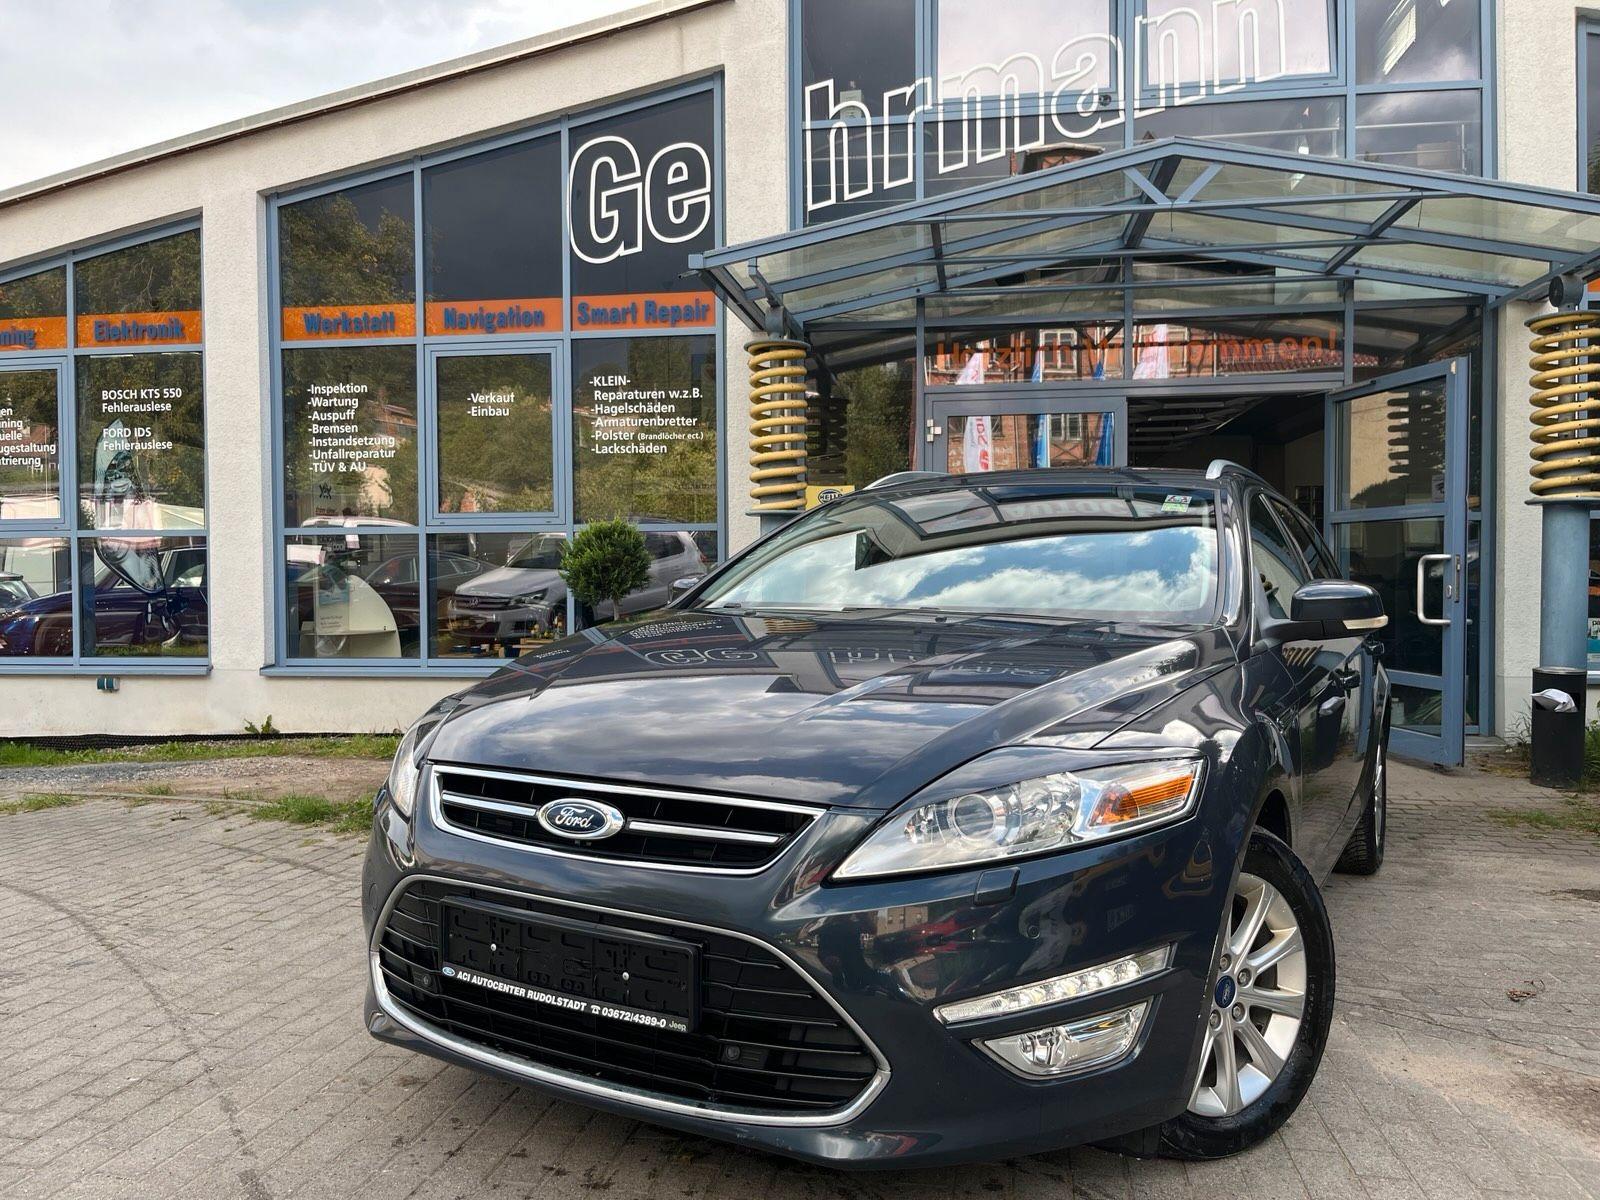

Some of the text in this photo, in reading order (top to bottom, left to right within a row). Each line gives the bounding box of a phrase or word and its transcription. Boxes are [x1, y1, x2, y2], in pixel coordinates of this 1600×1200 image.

[568, 135, 712, 264] Ge
[444, 304, 544, 334] Navigation
[577, 299, 709, 327] Smart Repair
[303, 311, 395, 334] Werkstatt
[94, 316, 185, 342] Elektronik
[589, 376, 631, 387] -KLEIN-
[102, 388, 182, 400] BOSCH KTS 550
[307, 383, 368, 396] -Inspektion
[594, 388, 703, 402] Reparaturen w.z.B.
[307, 397, 359, 408] -Wartung
[467, 392, 515, 403] -Verkauf
[0, 407, 13, 418] en
[102, 402, 172, 413] Fehlerauslese
[467, 405, 510, 417] -Einbau
[590, 402, 676, 416] -Hagelschäden
[308, 409, 355, 422] -Auspuff
[591, 415, 698, 428] -Armaturenbretter
[0, 418, 23, 430] ning
[308, 424, 359, 433] -Bremsen
[102, 427, 152, 438] FORD IDS
[591, 429, 635, 441] -Polster
[103, 439, 173, 451] Fehlerauslese
[308, 436, 395, 448] -Instandsetzung
[591, 442, 668, 454] -Lackschäden
[308, 448, 396, 461] -Unfallreparatur
[0, 455, 41, 468] trierung
[309, 460, 366, 472] -TÜV & AU
[555, 806, 594, 828] Ford
[457, 971, 471, 982] ACI
[472, 975, 526, 998] AUTOCENTER
[526, 990, 587, 1012] RUDOLSTADT
